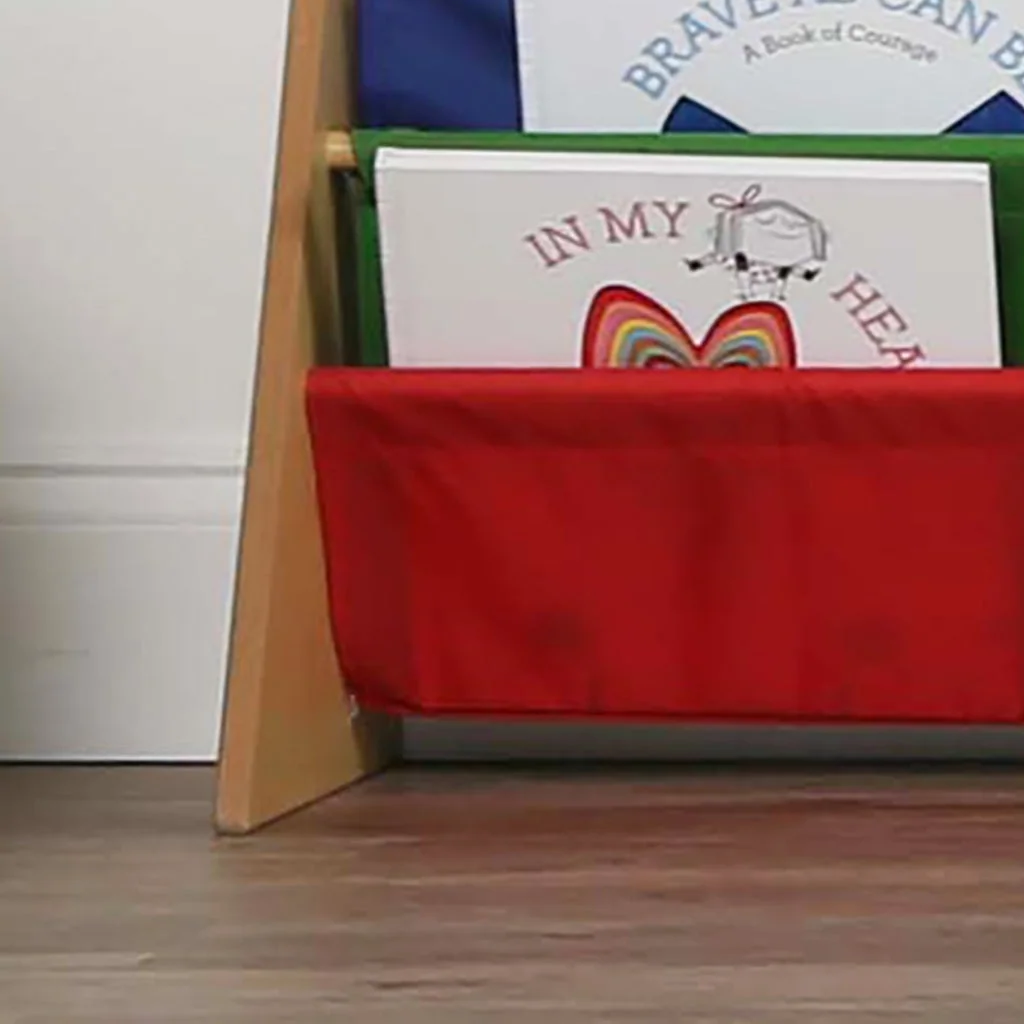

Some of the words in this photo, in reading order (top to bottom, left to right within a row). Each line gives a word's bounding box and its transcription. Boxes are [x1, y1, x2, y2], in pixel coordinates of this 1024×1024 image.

[743, 44, 762, 63] A
[761, 24, 815, 54] Book
[821, 22, 842, 42] of
[848, 24, 938, 63] Courage
[523, 215, 592, 268] IN
[598, 201, 690, 243] MY
[829, 272, 926, 369] HEA
